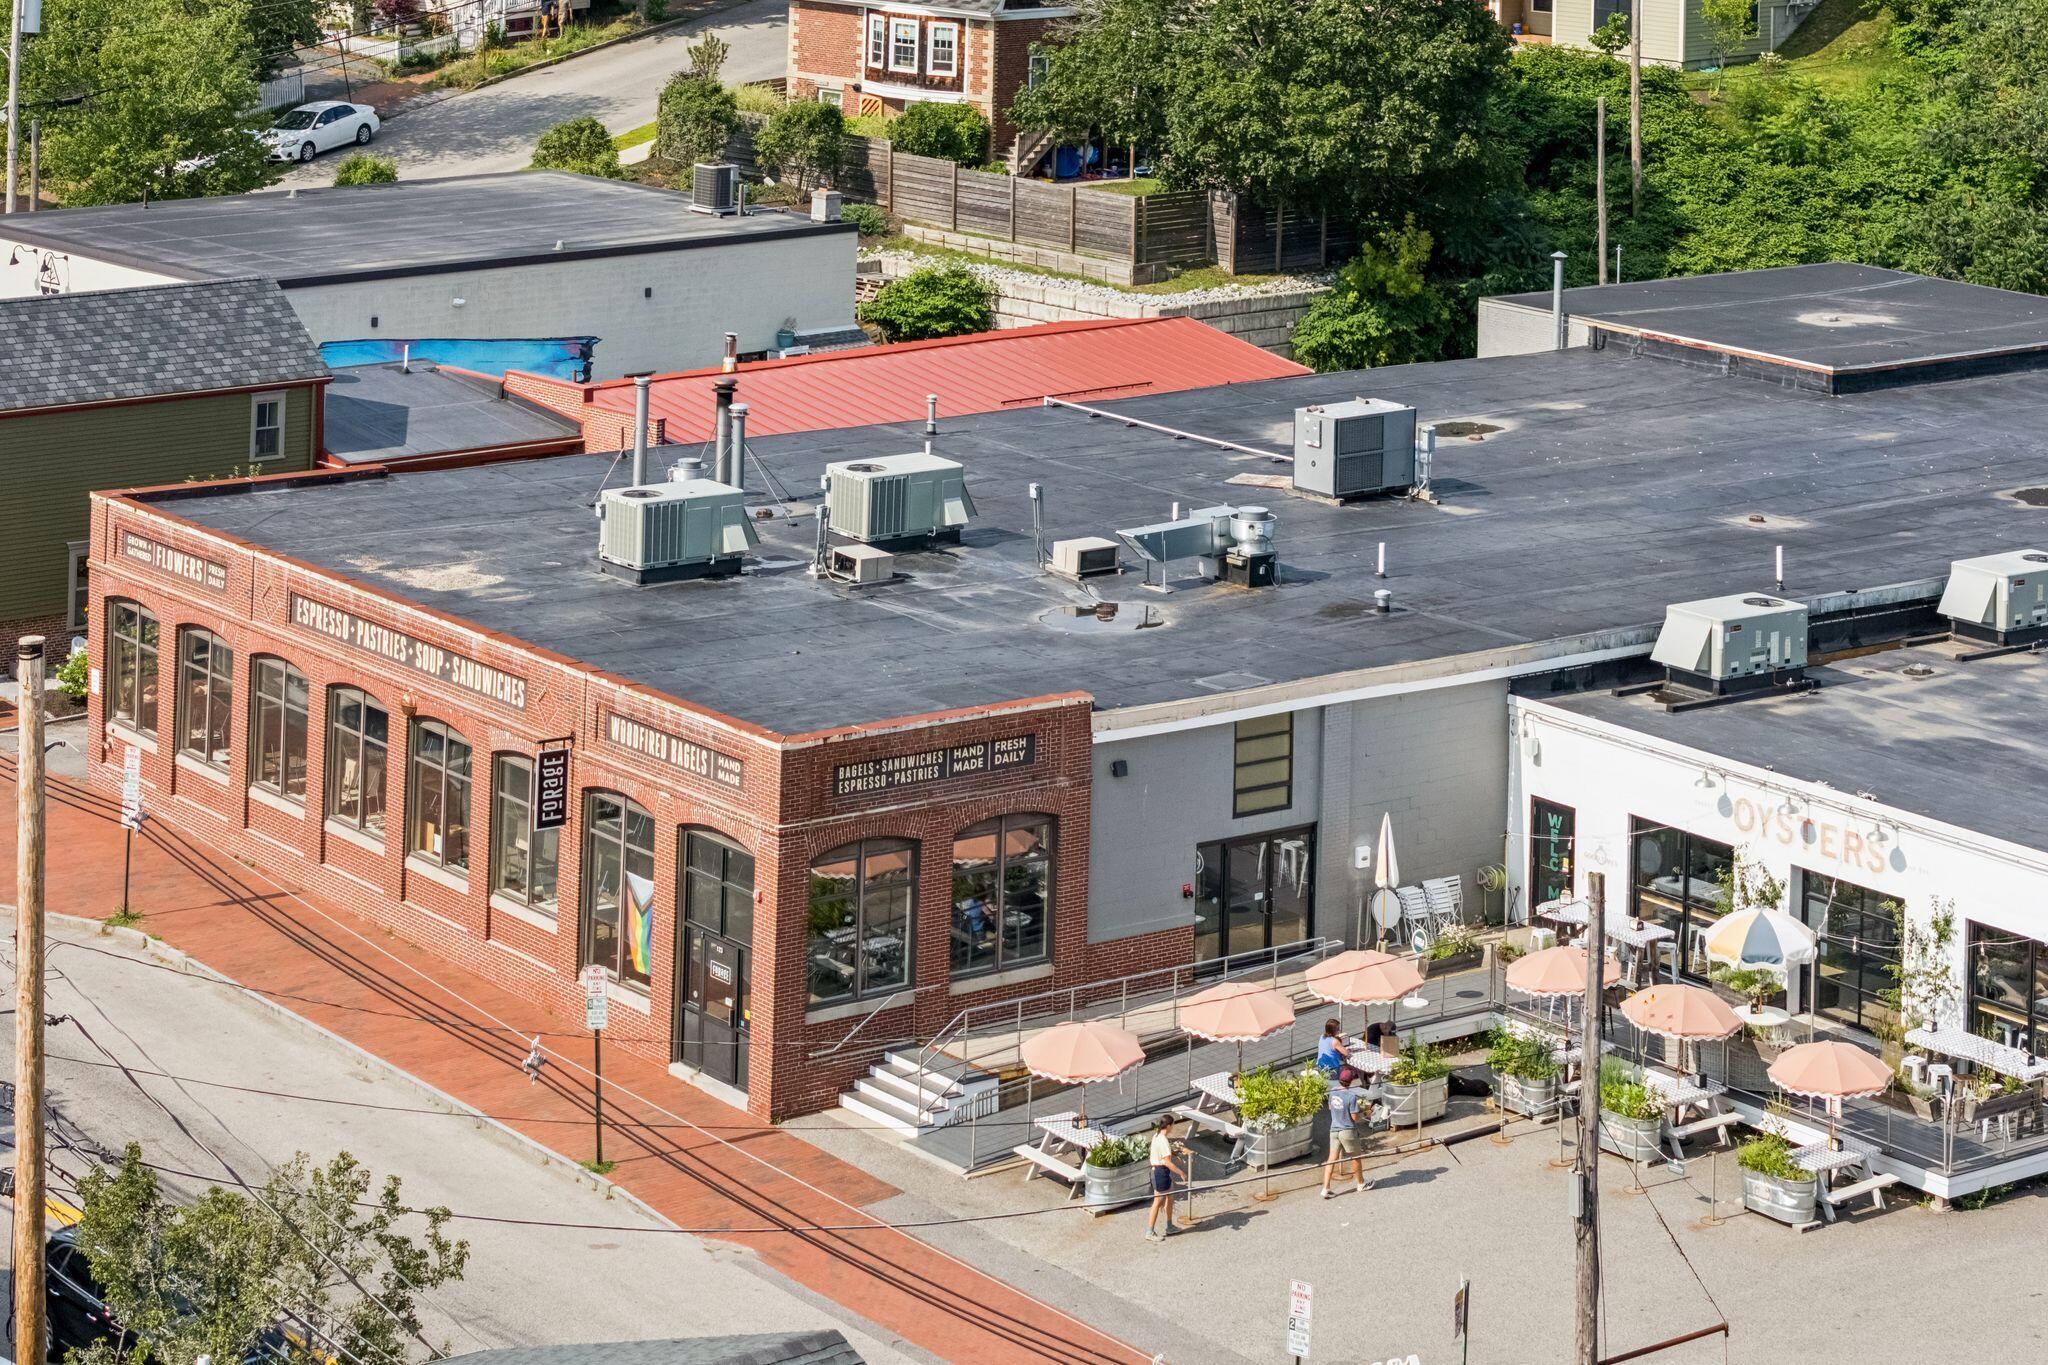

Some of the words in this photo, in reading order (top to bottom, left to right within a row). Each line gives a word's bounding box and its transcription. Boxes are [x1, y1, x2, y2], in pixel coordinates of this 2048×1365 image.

[127, 535, 147, 549] GROWN
[127, 546, 152, 562] GATHERED
[156, 545, 203, 582] FLOWERS
[208, 564, 226, 578] FRESH
[208, 575, 225, 589] DAILY
[296, 597, 350, 640] ESPRESSO
[356, 620, 407, 662] PASTRIES
[415, 641, 443, 675] SOUP
[452, 656, 525, 708] SANDWICHES
[610, 715, 667, 760] WOODFIRED
[670, 738, 708, 775] BAGELS
[953, 744, 984, 760] HAND
[994, 737, 1027, 753] FRESH
[718, 755, 741, 773] HAND
[838, 761, 874, 780] BAGELS
[881, 750, 944, 772] SANDWICHES
[953, 757, 984, 773] MADE
[994, 749, 1026, 765] DAILY
[718, 769, 740, 786] MADE
[838, 774, 887, 794] ESPRESSO
[894, 765, 939, 785] PASTRIES
[1733, 797, 1886, 874] OYSTERS
[1547, 812, 1563, 900] WELCM
[1291, 1290, 1311, 1300] PARKING
[1297, 1283, 1306, 1291] NO
[1289, 1318, 1295, 1330] 2
